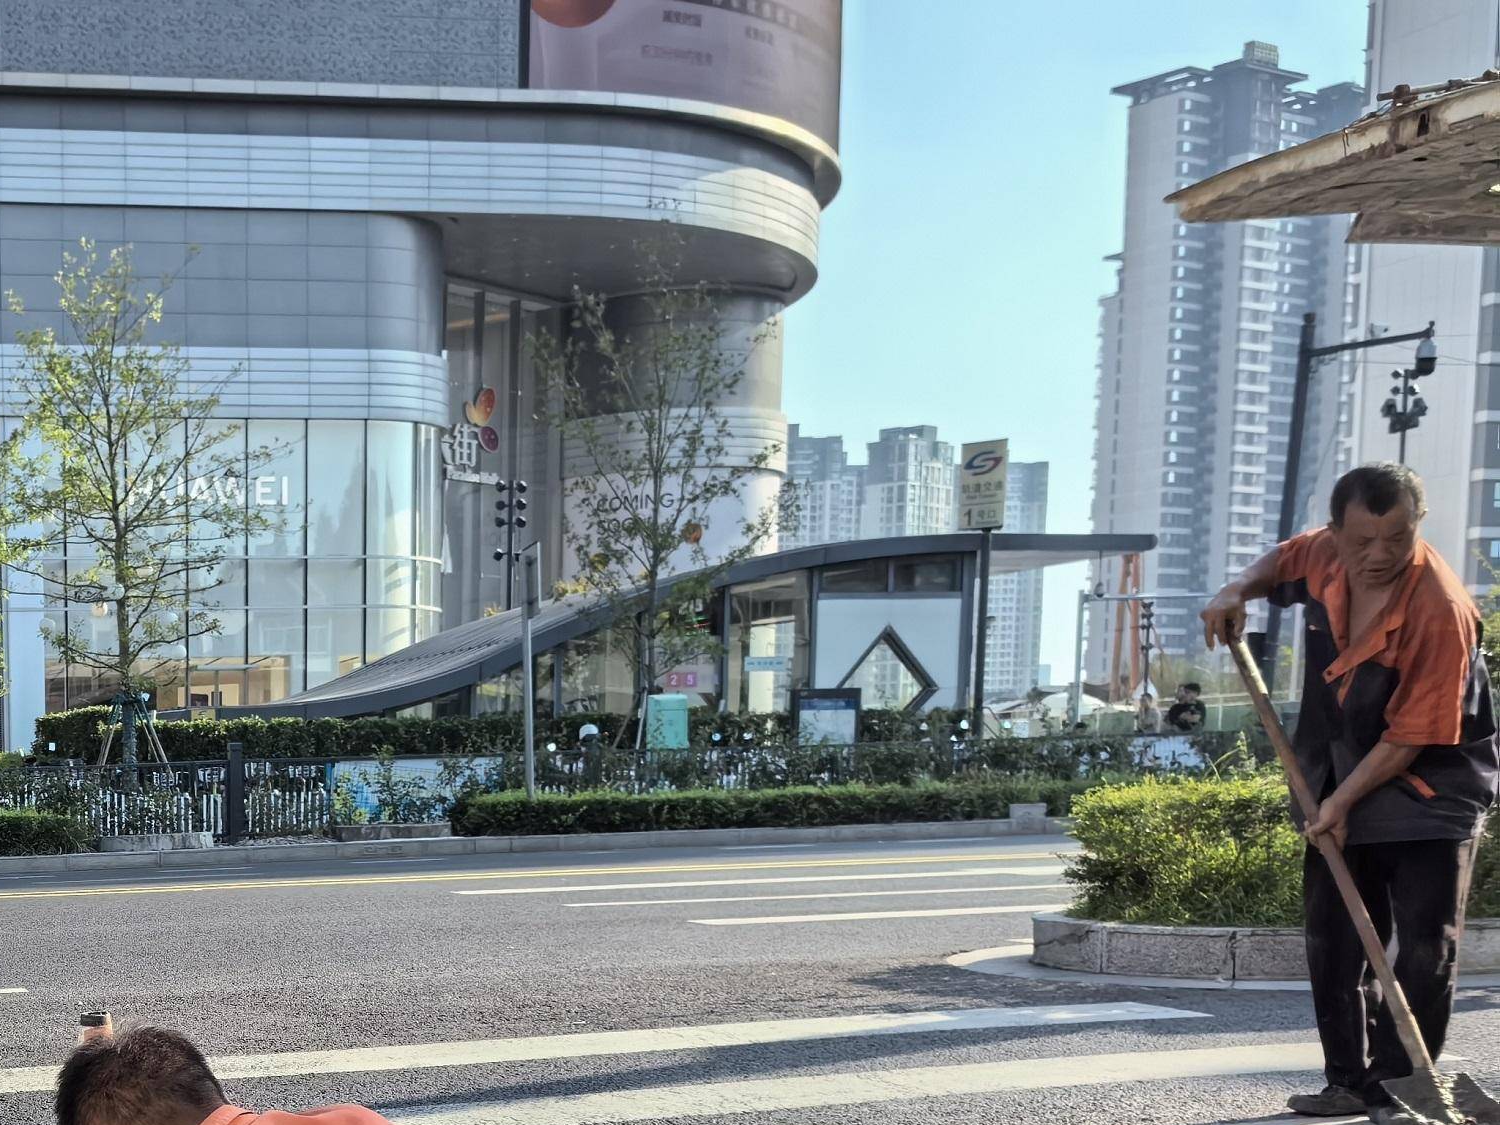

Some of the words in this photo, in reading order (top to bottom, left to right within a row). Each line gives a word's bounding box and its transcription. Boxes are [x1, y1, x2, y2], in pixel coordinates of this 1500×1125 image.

[127, 475, 289, 506] HUAWEI
[596, 493, 675, 512] COMING
[964, 508, 972, 526] 1
